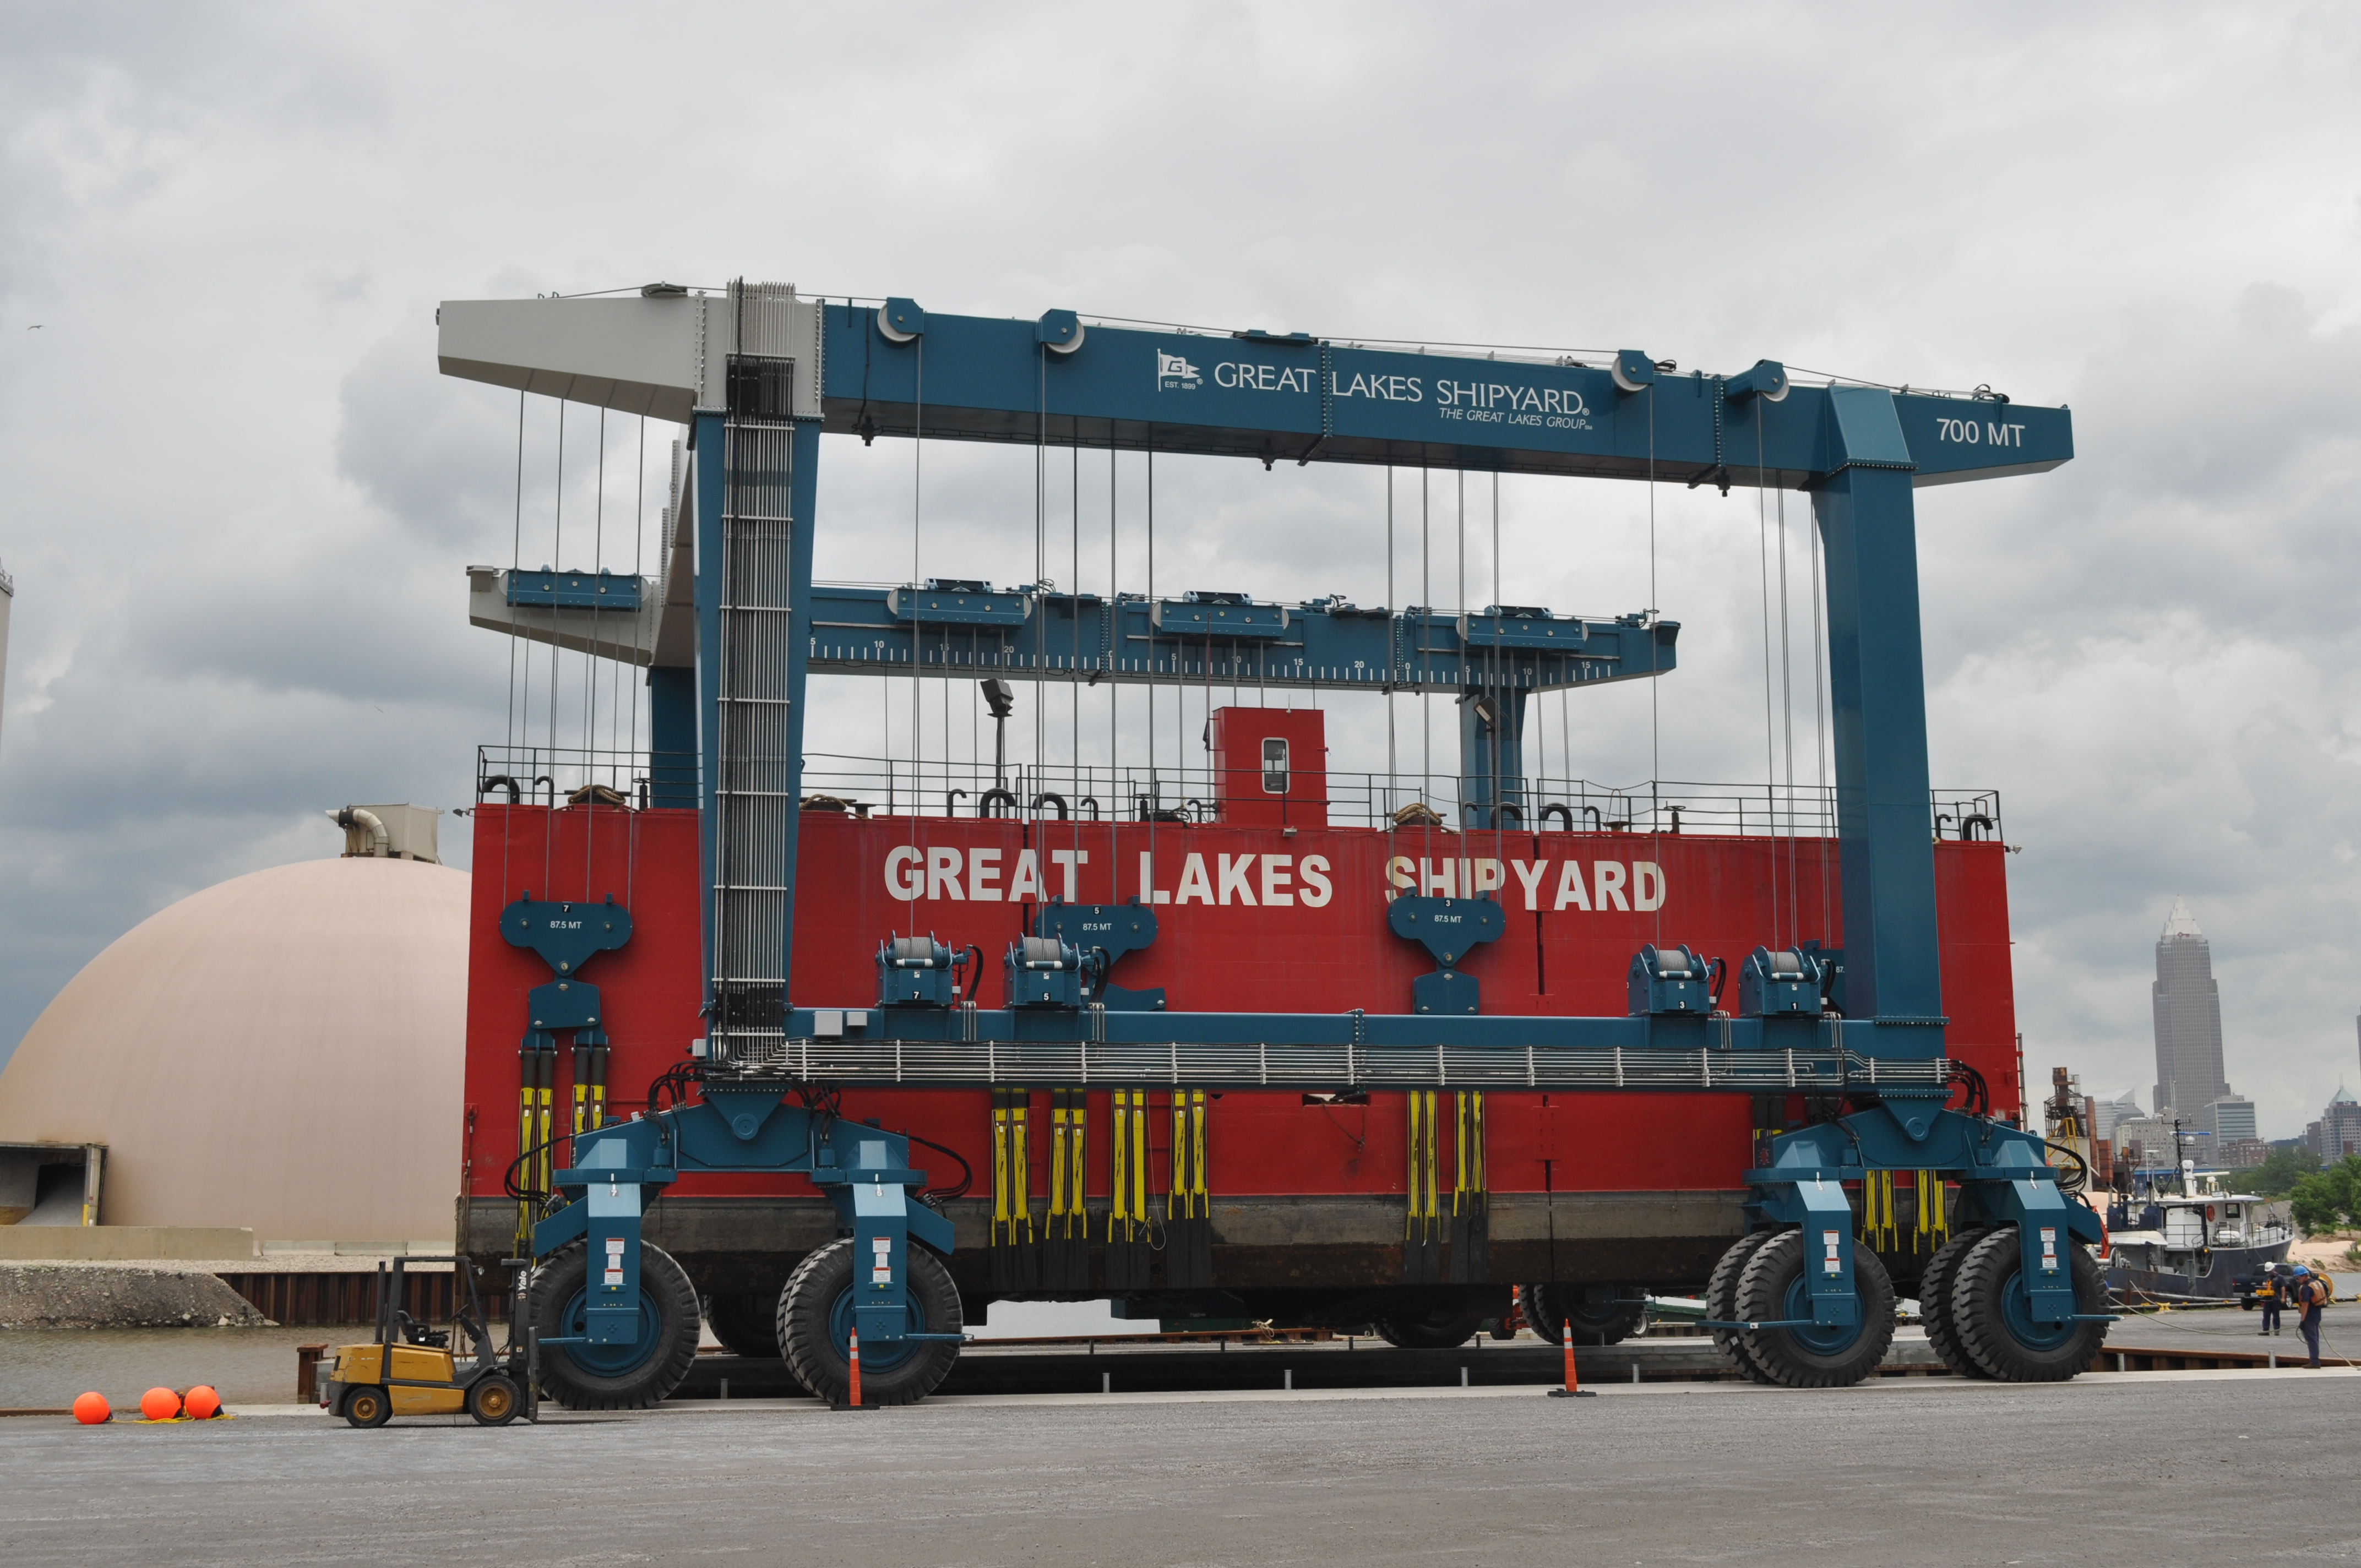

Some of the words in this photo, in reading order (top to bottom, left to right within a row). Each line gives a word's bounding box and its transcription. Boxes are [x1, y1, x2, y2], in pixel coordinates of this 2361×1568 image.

[1215, 362, 1316, 393] GREAT
[1331, 371, 1422, 402] LAKES
[1439, 407, 1464, 420] THE
[1467, 410, 1505, 423] GREAT
[1508, 413, 1542, 426] LAKES
[1936, 418, 1979, 444] 700
[1988, 422, 2025, 447] MT
[1004, 645, 1014, 654] 20
[884, 845, 1088, 902] GREAT
[1140, 851, 1332, 907] LAKES
[1384, 856, 1666, 912] SHIPYARD
[550, 921, 567, 929] 87.5
[568, 921, 583, 929] MT
[1434, 914, 1449, 923] 87.5
[913, 991, 920, 999] 7
[518, 1270, 527, 1291] Yale
